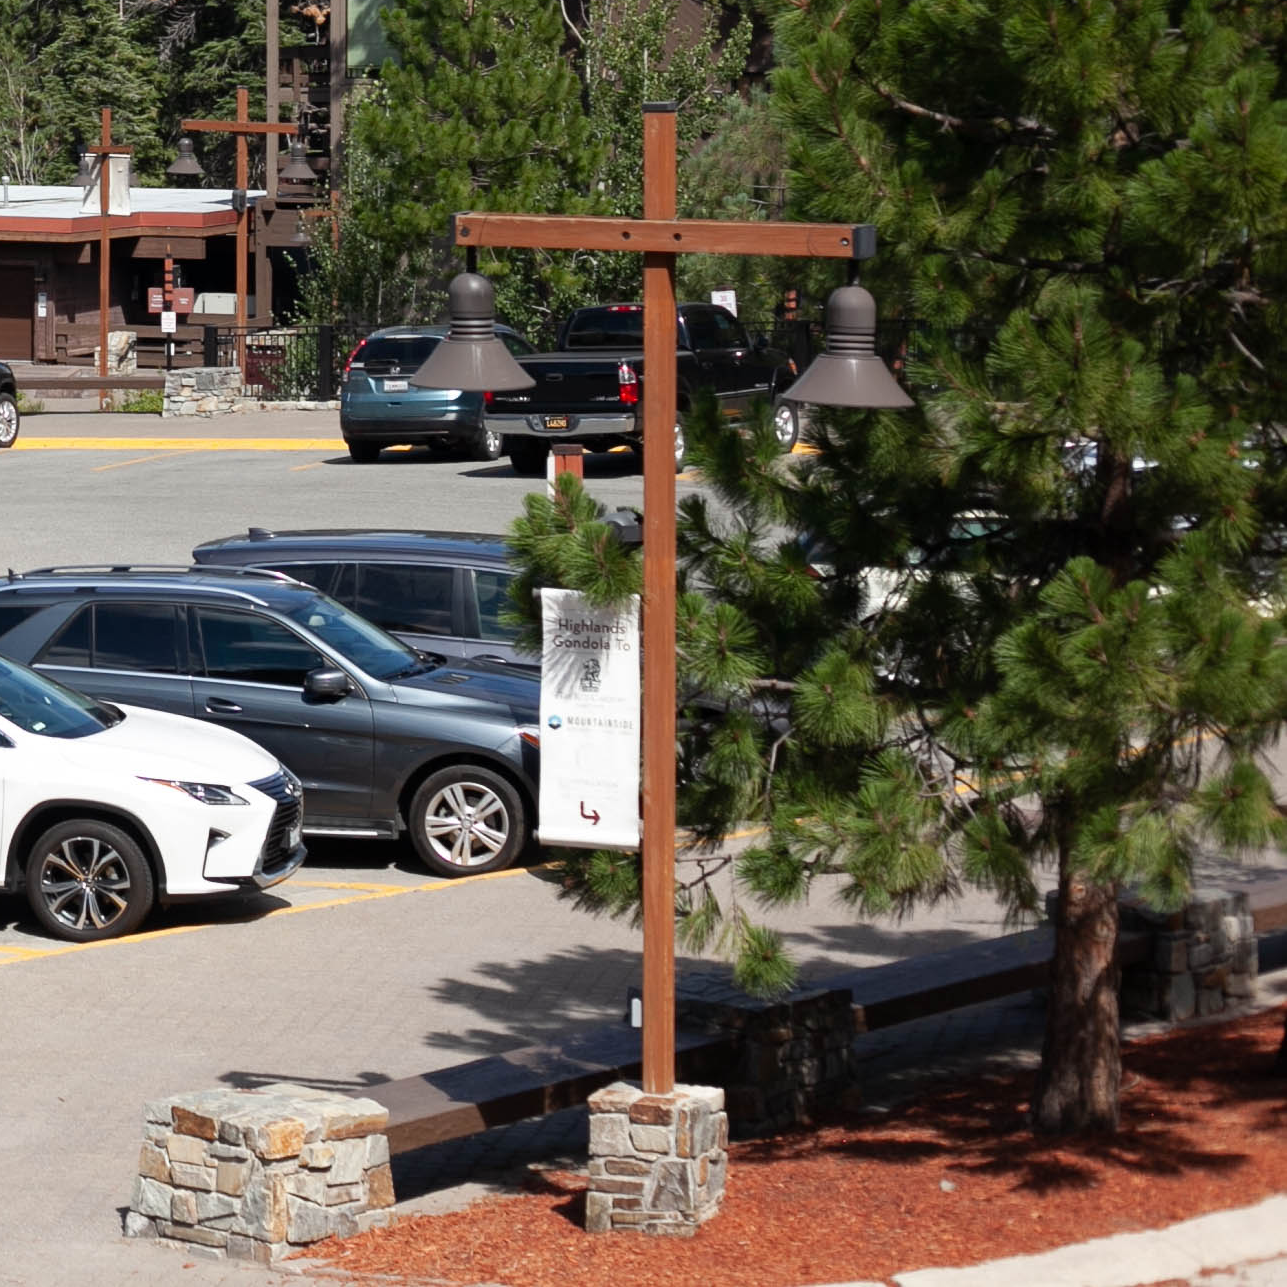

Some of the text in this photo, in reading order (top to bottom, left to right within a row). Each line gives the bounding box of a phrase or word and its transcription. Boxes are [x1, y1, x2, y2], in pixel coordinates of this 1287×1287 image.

[558, 618, 626, 635] Highlands
[553, 635, 631, 651] Gondola To
[567, 716, 634, 730] MOUNTAINSIDE
